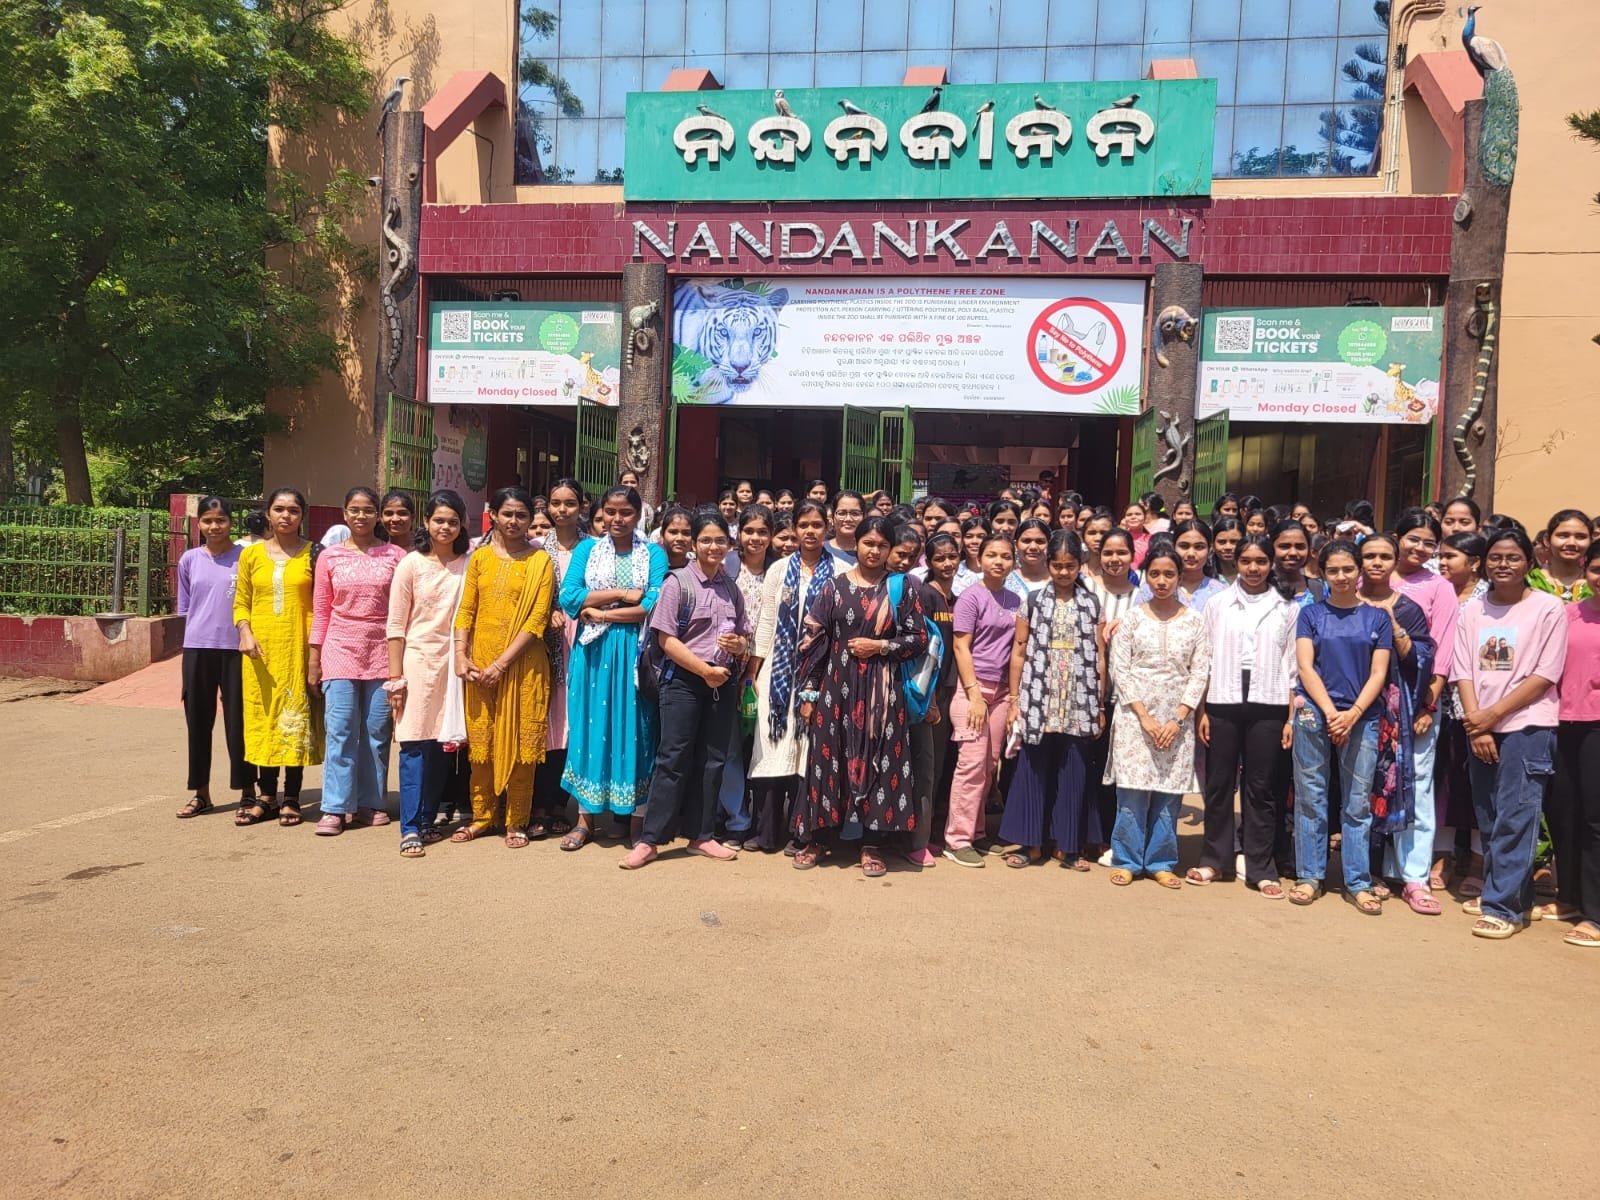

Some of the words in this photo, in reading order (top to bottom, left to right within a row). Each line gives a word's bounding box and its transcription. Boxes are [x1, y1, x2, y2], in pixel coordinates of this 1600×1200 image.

[673, 110, 1154, 164] ନନ୍ଦନକାନନ
[633, 219, 1193, 261] NANDANKANAN
[474, 311, 490, 319] Scan
[473, 319, 509, 331] BOOK
[1256, 318, 1278, 327] Scan
[1294, 318, 1301, 327] &
[473, 332, 524, 343] TICKETS
[824, 333, 874, 342] ନନ୍ଦନକାନନ
[879, 333, 894, 342] ଏକ
[1049, 326, 1061, 339] Say
[1255, 328, 1300, 340] BOOK
[1254, 341, 1318, 354] TICKETS
[477, 386, 520, 398] Monday
[522, 387, 558, 397] Closed
[1257, 402, 1310, 415] Monday
[1312, 403, 1357, 413] Closed
